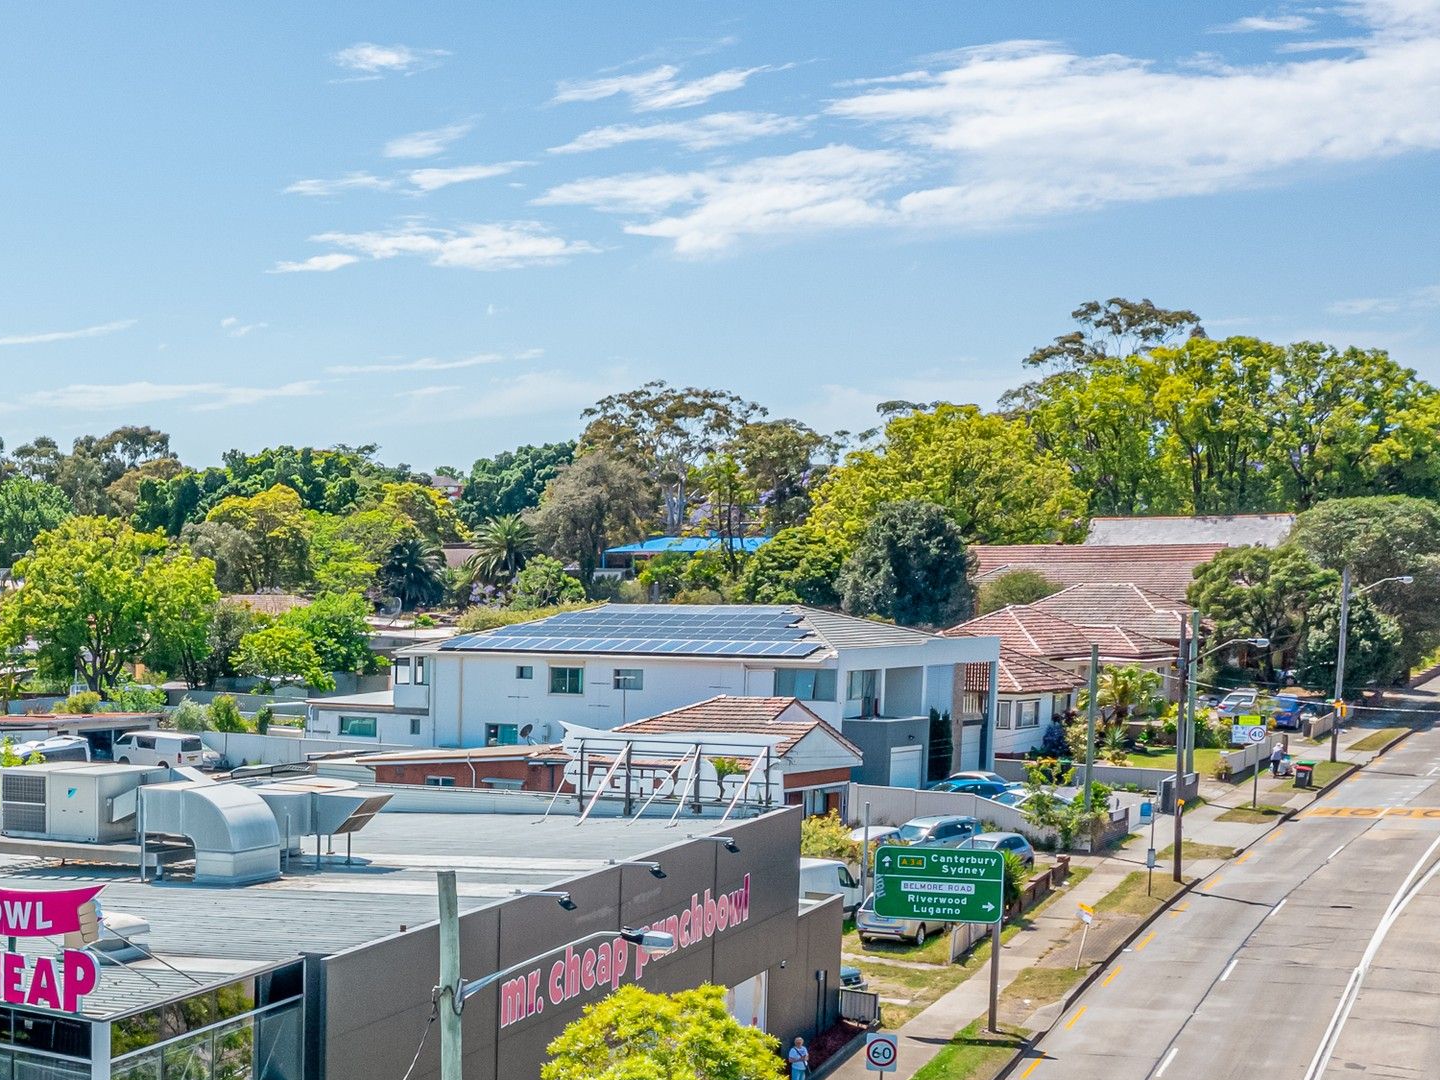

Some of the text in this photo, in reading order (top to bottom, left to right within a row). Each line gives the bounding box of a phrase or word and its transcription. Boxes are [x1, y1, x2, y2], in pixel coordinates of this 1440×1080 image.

[931, 854, 997, 867] Canterbury
[941, 864, 986, 877] Sydney
[903, 882, 973, 893] BELMORE ROAD
[907, 894, 967, 905] Riverwood
[913, 905, 961, 916] Lugarno
[501, 968, 544, 1029] mr.
[548, 937, 629, 1006] cheap
[872, 1047, 892, 1060] 60
